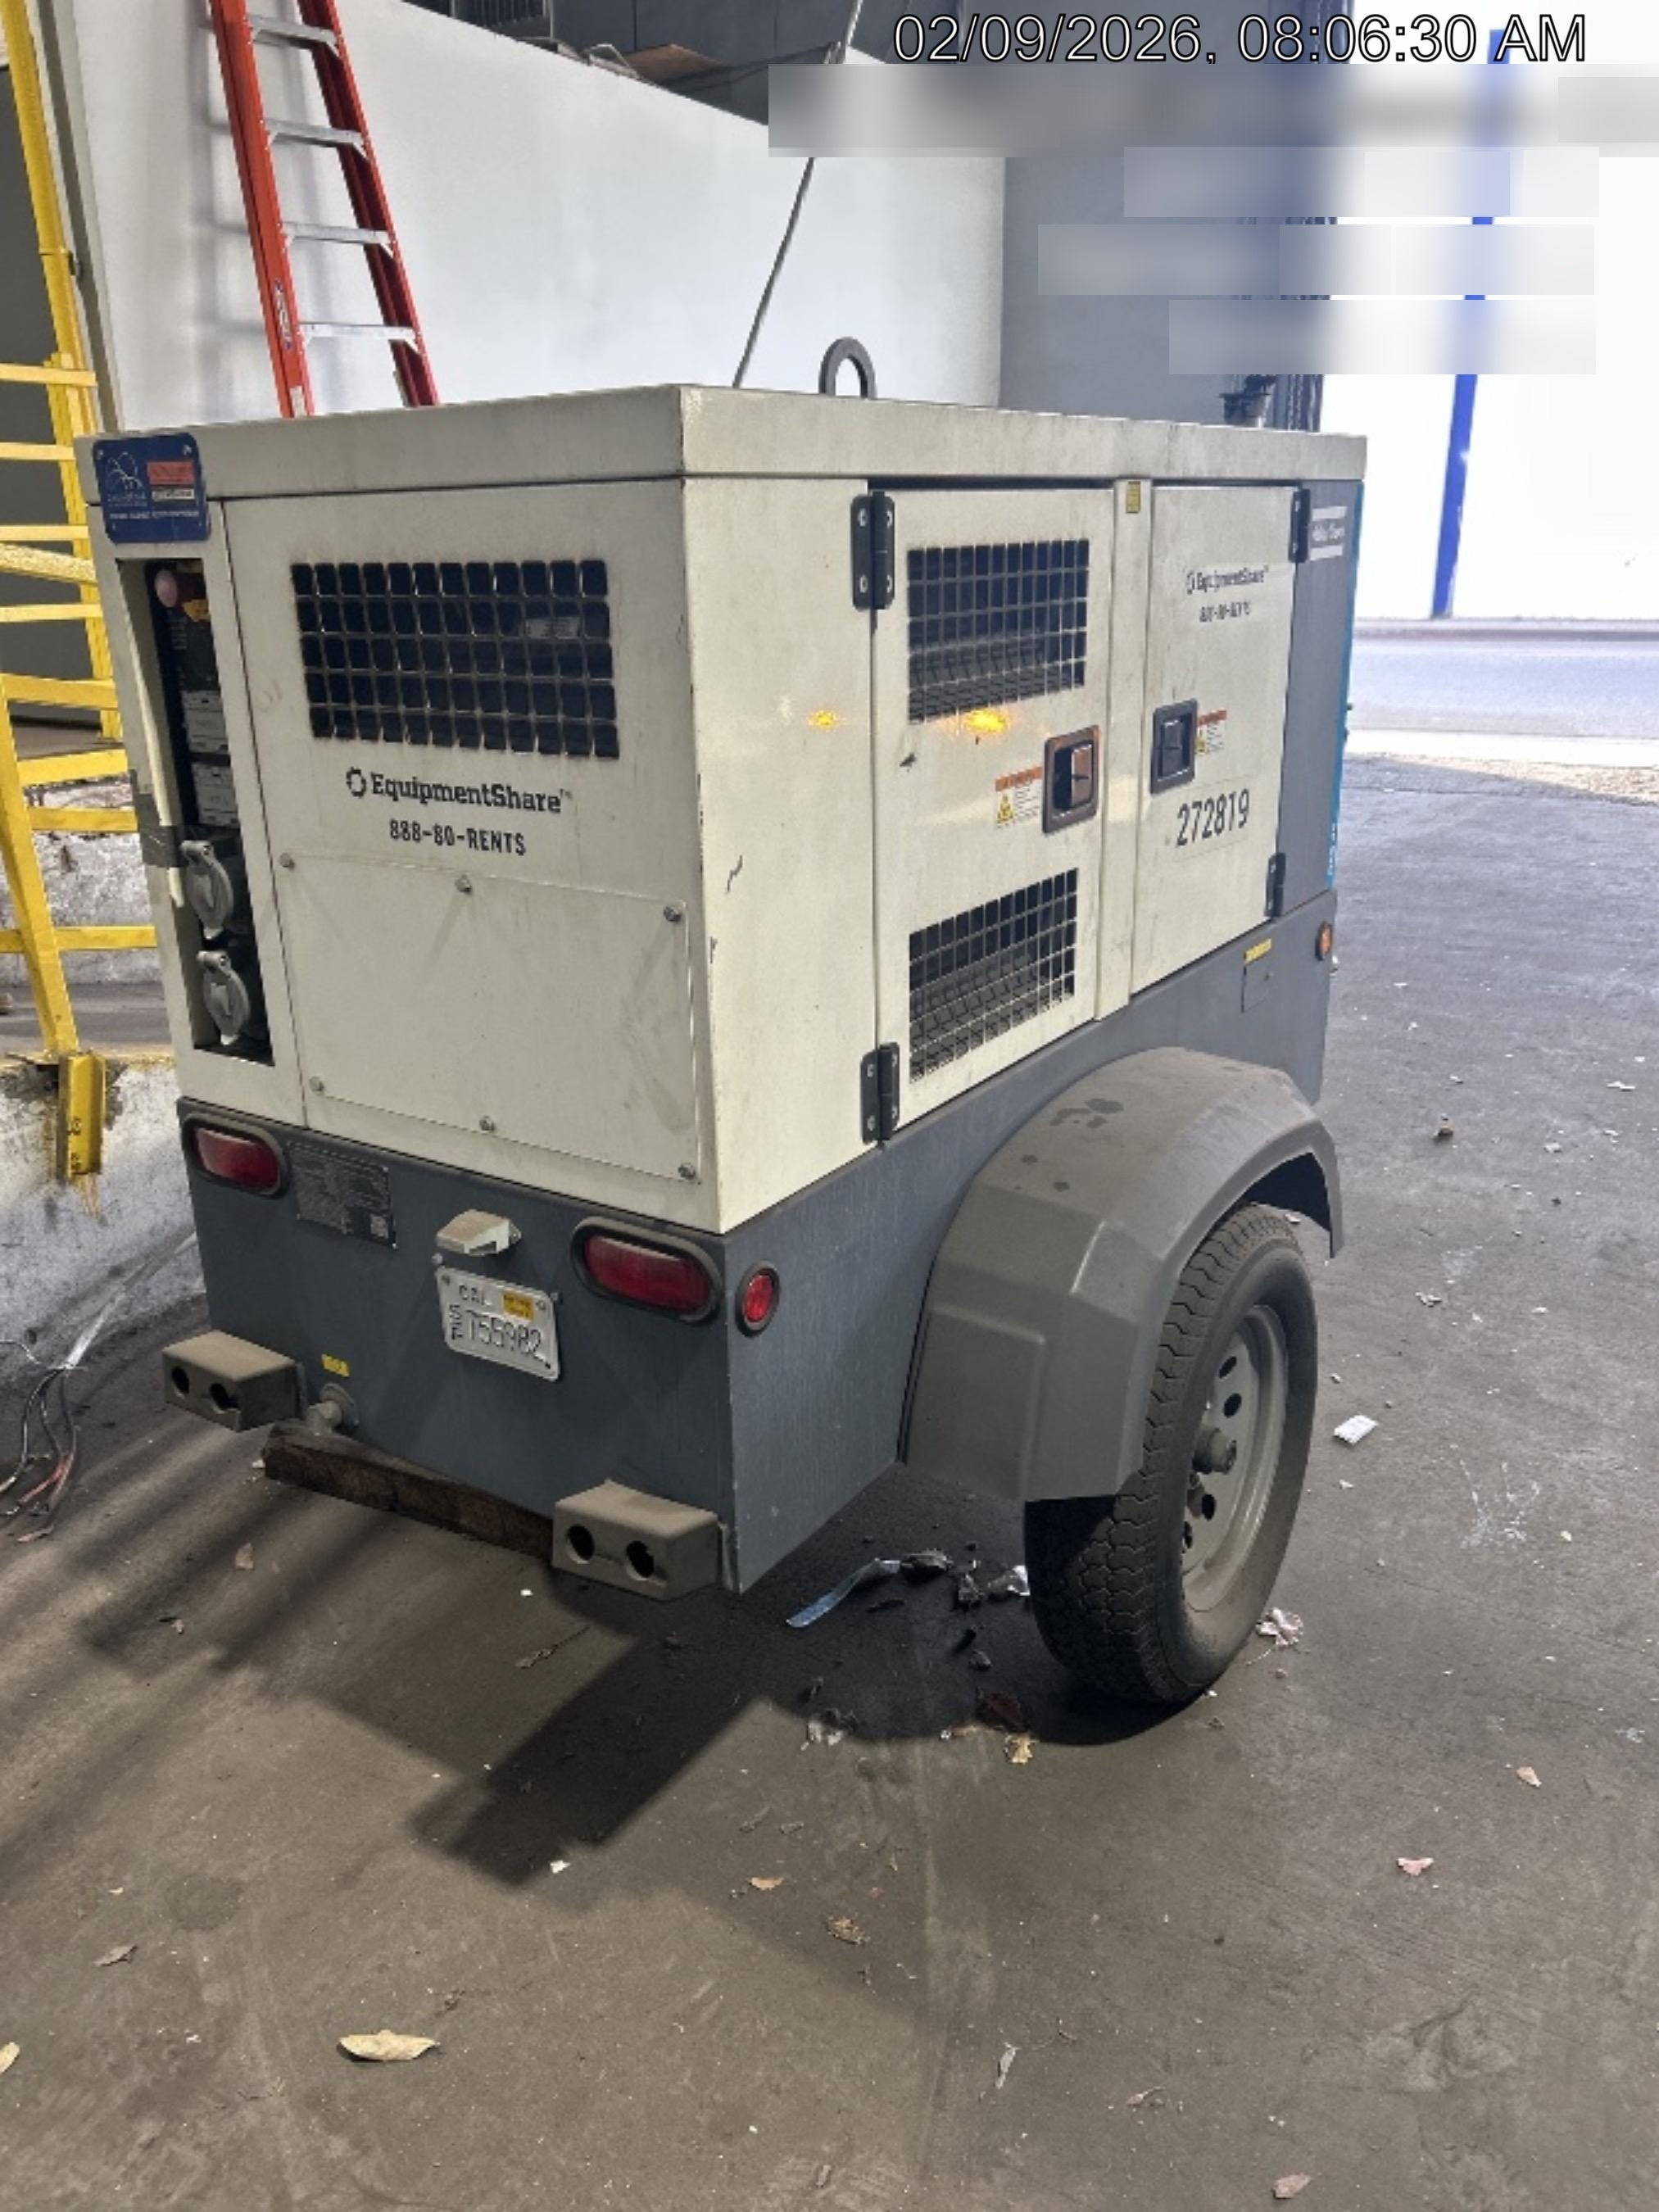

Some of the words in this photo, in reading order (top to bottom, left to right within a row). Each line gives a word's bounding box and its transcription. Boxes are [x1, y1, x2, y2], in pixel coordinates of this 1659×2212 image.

[371, 773, 562, 813] EquipmentShare
[1176, 787, 1250, 847] 272819
[389, 819, 527, 856] 888-80-RENTS
